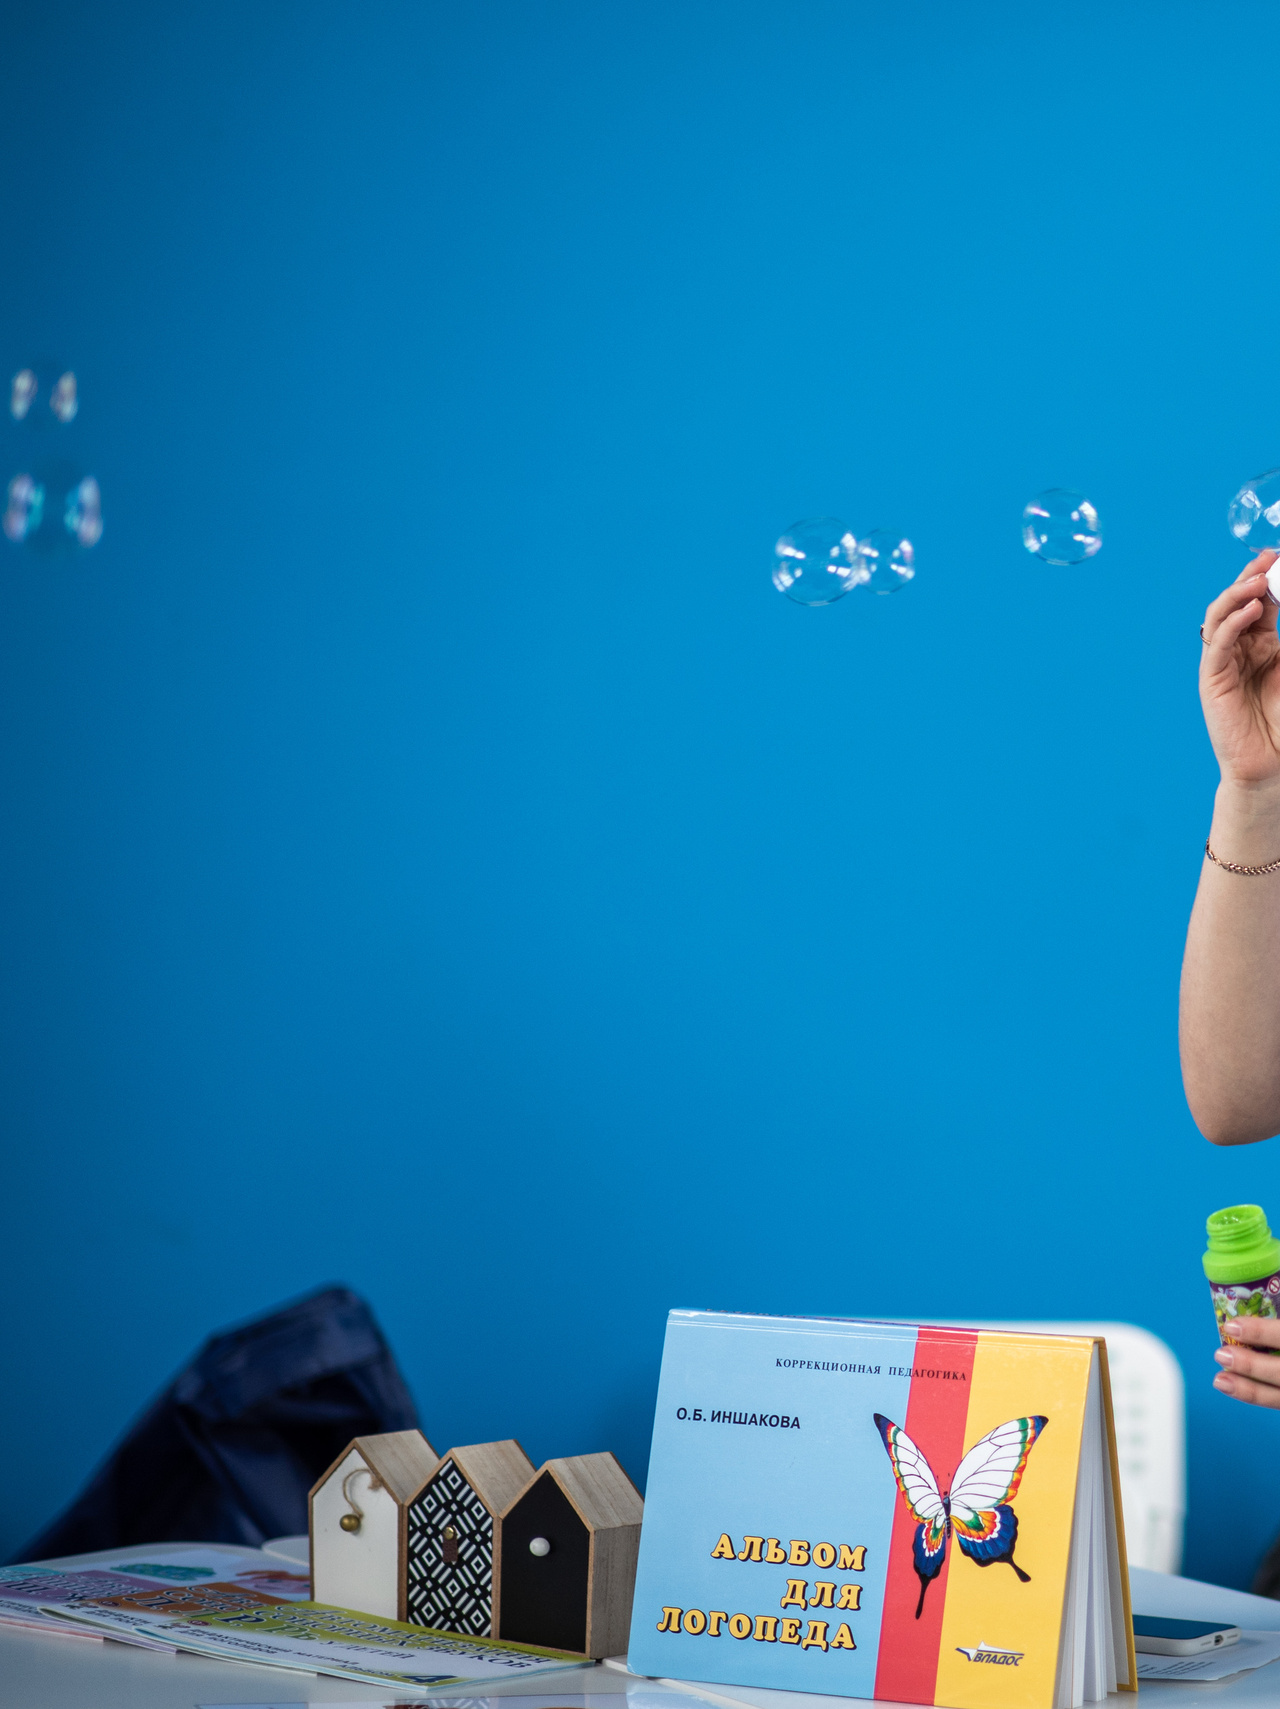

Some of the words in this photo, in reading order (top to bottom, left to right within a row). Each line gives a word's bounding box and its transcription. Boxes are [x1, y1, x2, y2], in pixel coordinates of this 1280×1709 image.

[775, 1357, 881, 1375] КОРРЕКЦИОННАЯ
[888, 1366, 967, 1381] ПЕДАГОГИКА
[676, 1407, 707, 1423] О.Б.
[710, 1410, 801, 1430] ИНШАКОВА
[710, 1533, 867, 1573] АЛЬБОМ
[781, 1579, 861, 1611] ДЛЯ
[656, 1607, 857, 1652] ЛОГОПЕДА
[973, 1653, 1024, 1667] ВЛАДОС
[402, 1675, 459, 1683] 4
